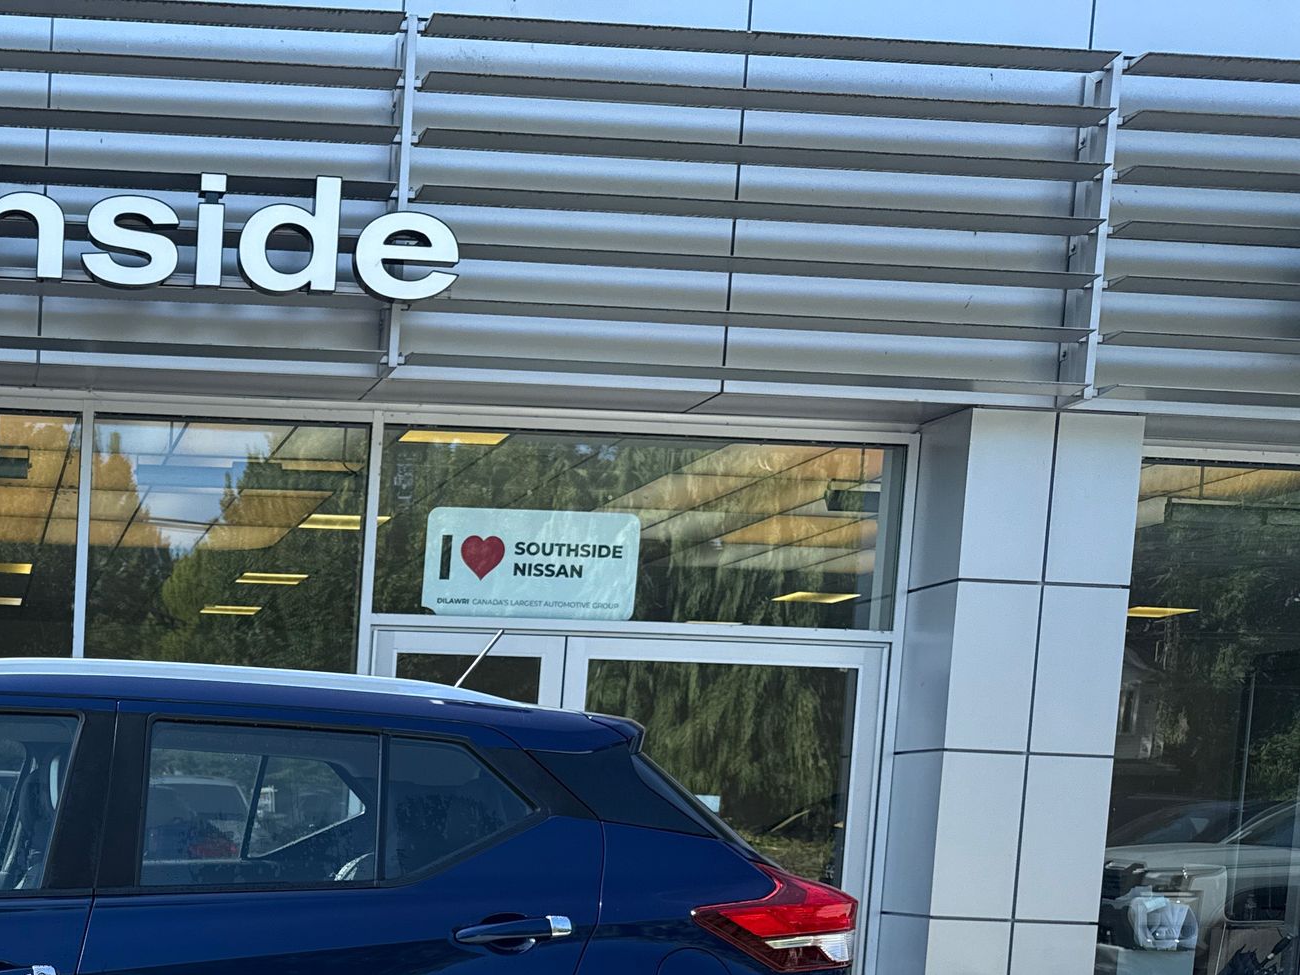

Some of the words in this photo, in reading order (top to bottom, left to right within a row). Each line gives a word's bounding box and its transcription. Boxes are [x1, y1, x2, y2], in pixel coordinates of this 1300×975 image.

[439, 535, 453, 580] I
[514, 541, 624, 559] SOUTHSIDE
[513, 562, 583, 579] NISSAN
[436, 597, 470, 605] DILAWRI
[510, 599, 542, 608] LARGEST
[543, 600, 591, 609] AUTOMOTIVE
[592, 601, 619, 610] GROUP
